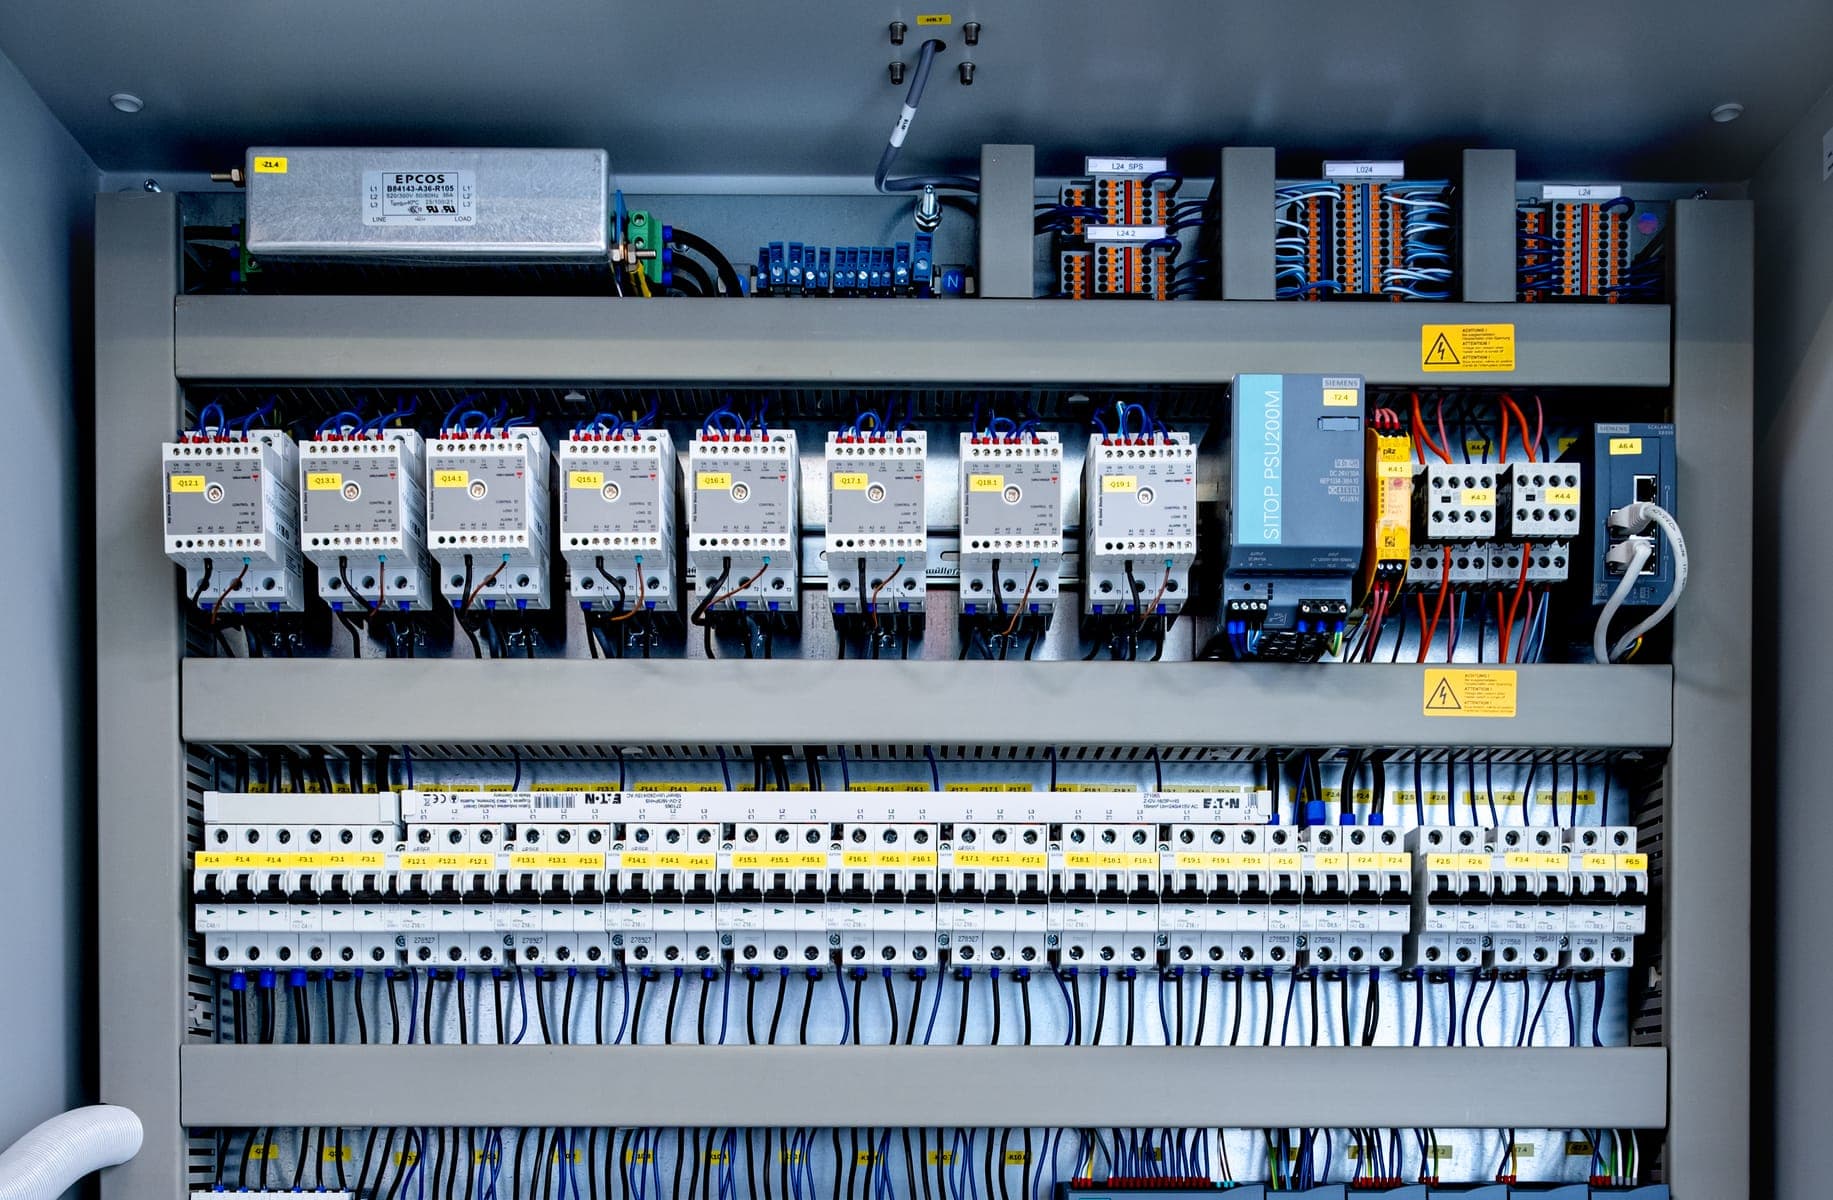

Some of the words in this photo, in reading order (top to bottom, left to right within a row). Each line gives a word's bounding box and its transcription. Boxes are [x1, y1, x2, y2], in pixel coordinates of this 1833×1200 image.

[396, 174, 445, 184] EPCOS
[1578, 188, 1591, 197] L24
[947, 275, 958, 287] N
[1324, 378, 1359, 387] SIEMENS
[1598, 425, 1629, 433] SIEMENS
[1264, 390, 1281, 479] PSU200M
[1264, 486, 1280, 539] SITOP
